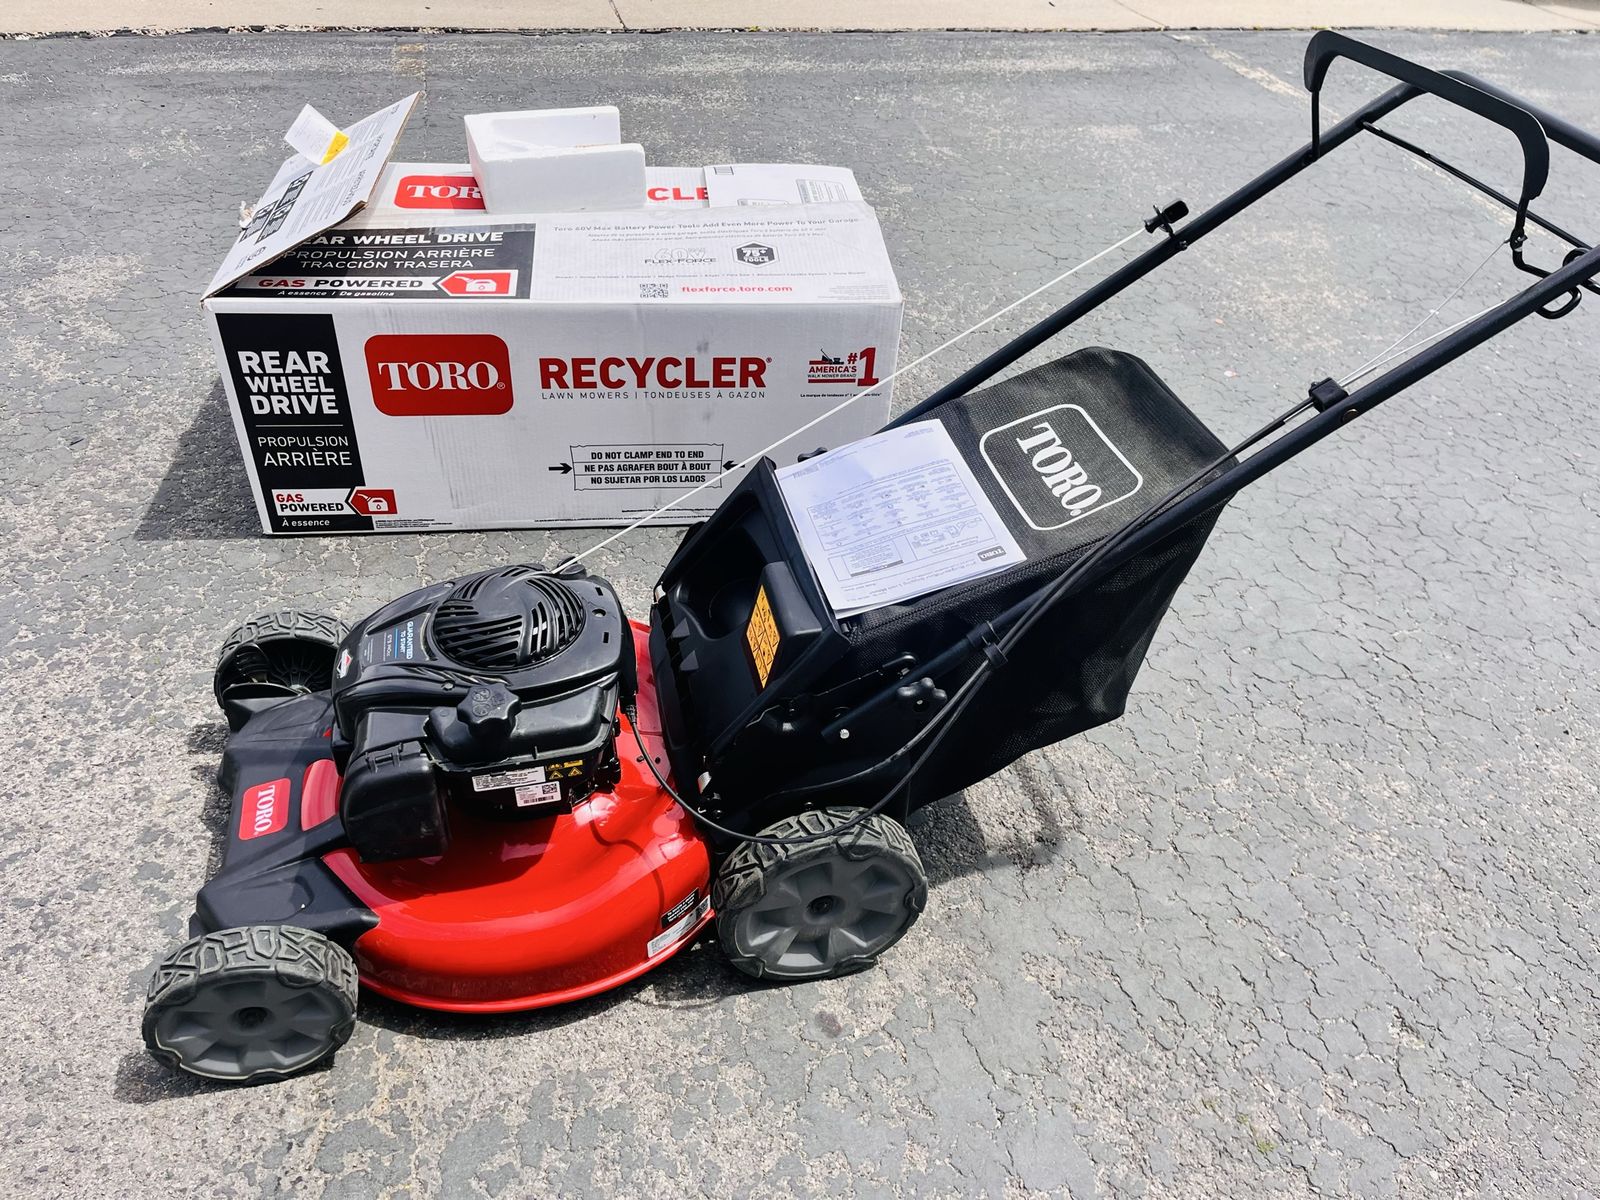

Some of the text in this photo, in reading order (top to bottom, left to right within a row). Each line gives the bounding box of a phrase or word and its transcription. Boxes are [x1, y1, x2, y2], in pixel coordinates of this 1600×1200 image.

[407, 185, 482, 199] TOR
[352, 234, 431, 245] WHEEL
[437, 232, 504, 243] DRIVE
[284, 248, 495, 259] PROPULSION ARRIÈRE
[300, 259, 474, 269] TRACCIÓN TRASERA
[237, 351, 332, 374] REAR
[847, 347, 879, 387] #1
[244, 376, 334, 393] WHEEL
[542, 392, 574, 400] LAWN
[643, 391, 711, 399] TONDEUSES
[716, 390, 723, 399] À
[728, 391, 765, 399] GAZON
[249, 395, 339, 415] DRIVE
[257, 436, 349, 447] PROPULSION
[264, 447, 353, 466] ARRIÈRE
[591, 452, 602, 460] DO
[624, 451, 654, 459] CLAMP
[656, 451, 672, 459] END
[675, 451, 685, 459] TO
[584, 461, 711, 472] NE PAS AGRAFER BOUT À BOUT
[605, 476, 642, 484] SUJETAR
[662, 475, 678, 483] LOS
[680, 475, 706, 483] LADOS
[276, 494, 304, 503] GAS
[280, 503, 344, 512] POWERED
[282, 517, 330, 527] À essence
[406, 621, 414, 660] GUARANTEED
